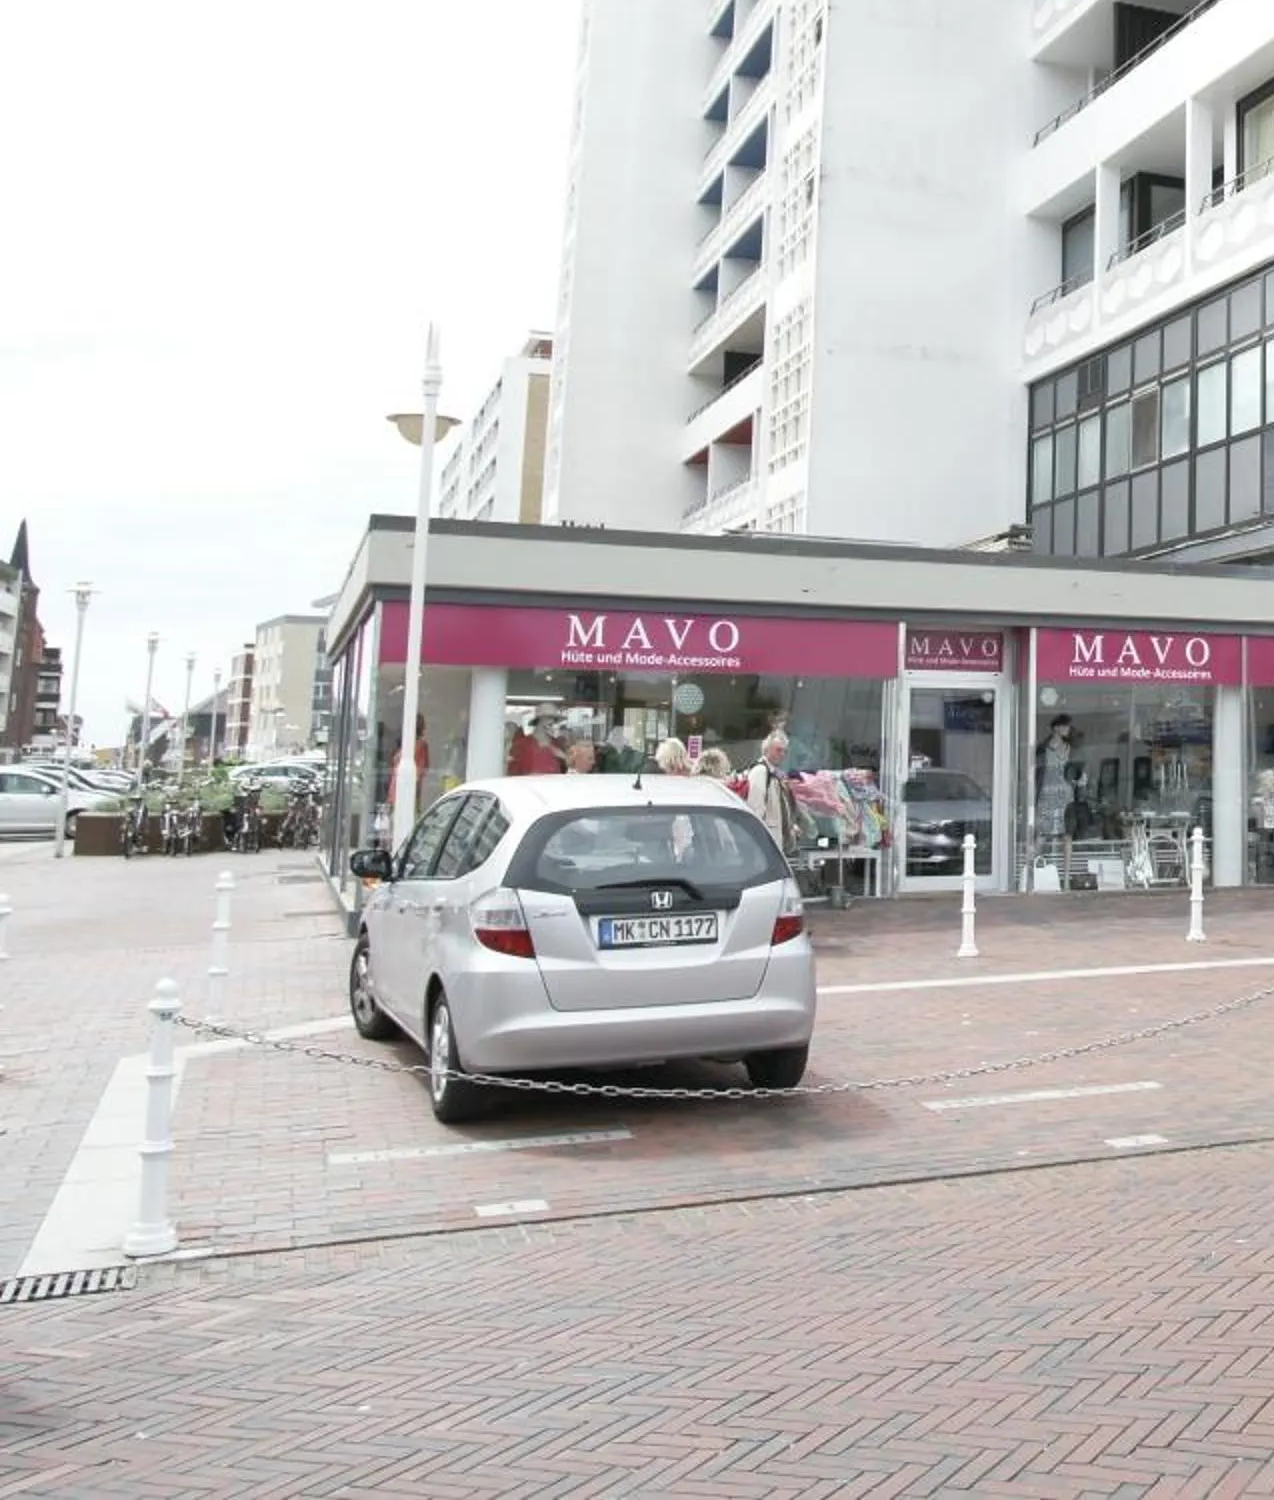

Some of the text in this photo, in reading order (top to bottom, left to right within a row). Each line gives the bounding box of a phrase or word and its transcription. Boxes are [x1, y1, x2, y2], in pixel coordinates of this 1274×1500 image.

[566, 614, 740, 652] MAVO
[911, 635, 998, 657] MAVO
[1072, 633, 1210, 666] MAVO
[561, 650, 741, 668] Hüte und Mode-Accessoires
[1069, 666, 1212, 680] Hüte und Mode-Accessoires
[613, 917, 713, 941] MK CN 1177
